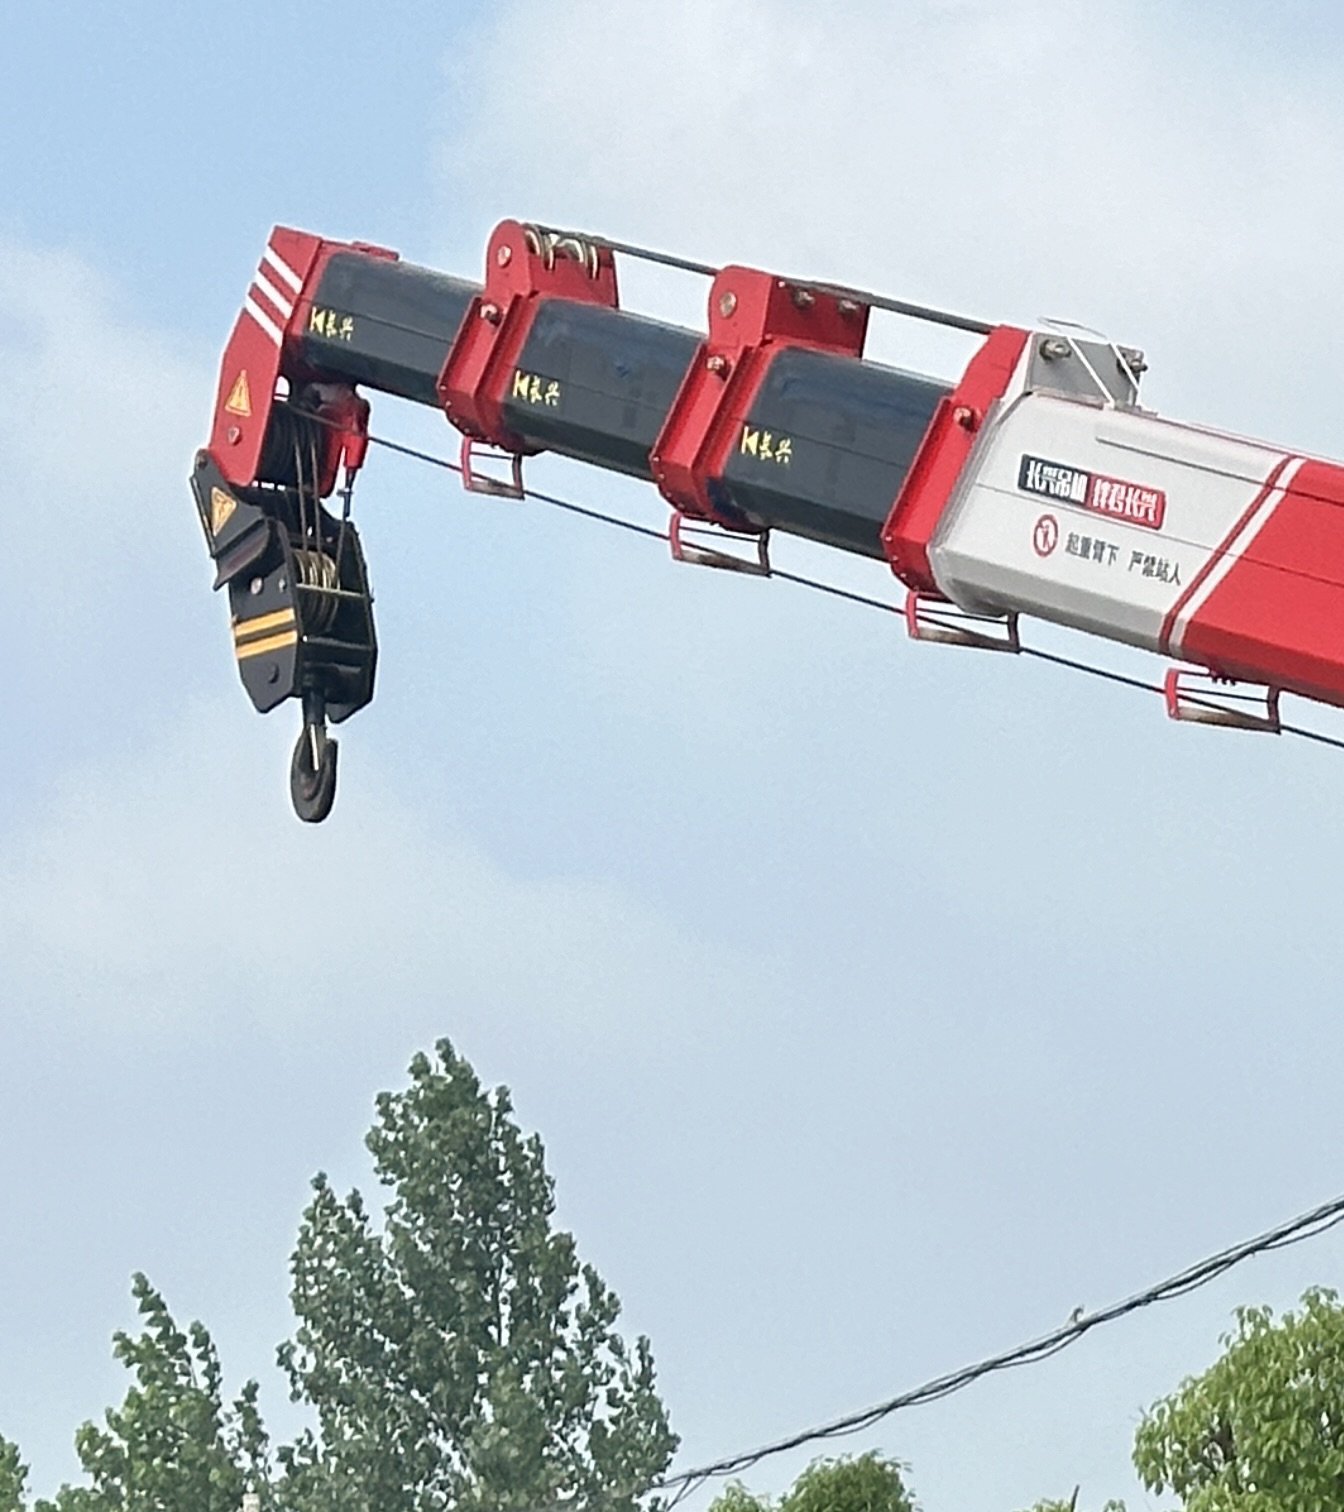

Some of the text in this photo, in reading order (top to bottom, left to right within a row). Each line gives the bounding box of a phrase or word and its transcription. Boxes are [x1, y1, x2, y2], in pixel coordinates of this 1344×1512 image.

[1065, 532, 1183, 587] 起重臂下 严禁站人
